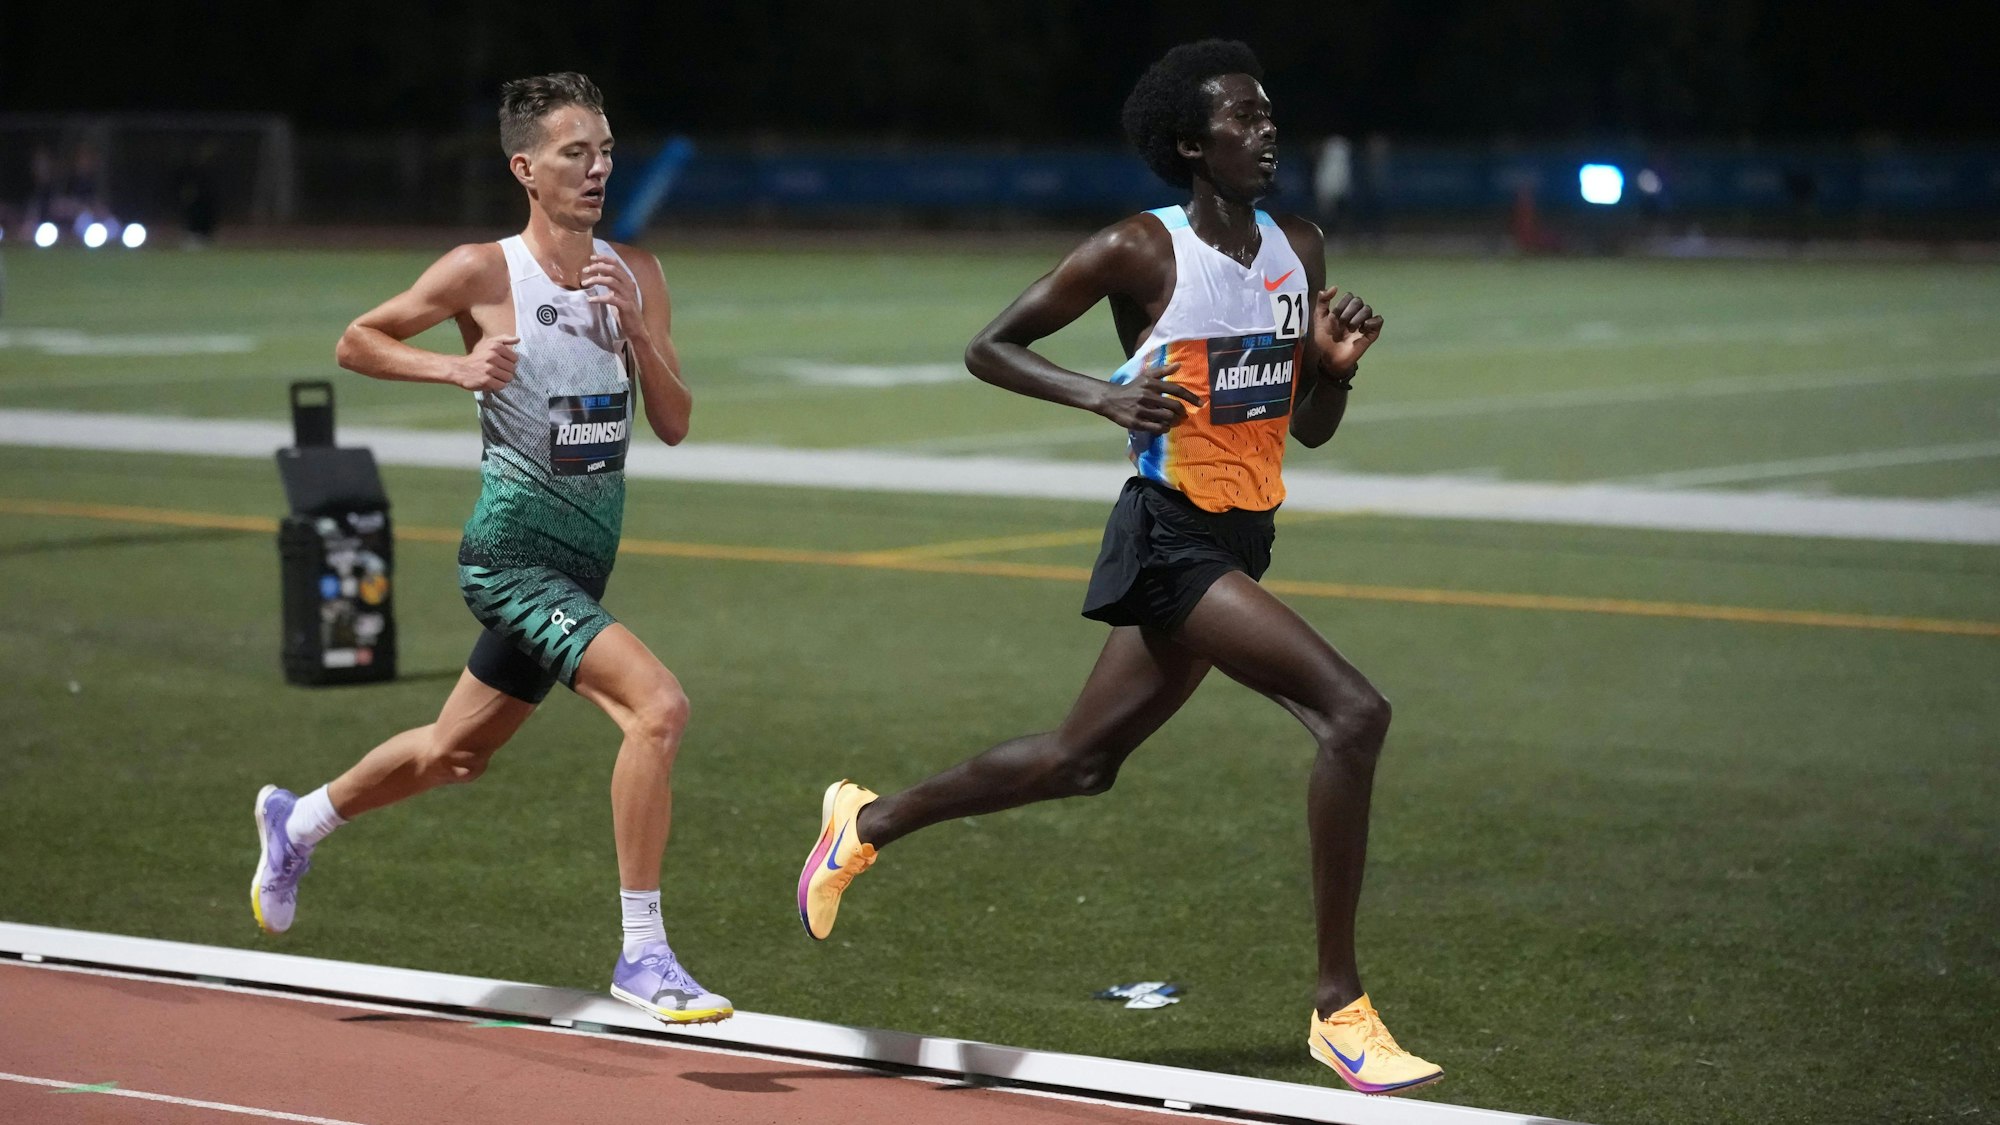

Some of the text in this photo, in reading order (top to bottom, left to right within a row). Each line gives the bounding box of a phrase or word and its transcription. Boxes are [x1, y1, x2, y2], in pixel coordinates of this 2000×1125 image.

[1277, 293, 1303, 334] 21
[1241, 335, 1272, 347] THE TEN
[1215, 360, 1293, 391] ABDILAAHI
[583, 396, 611, 407] THE TEN
[1246, 405, 1267, 419] HOKA
[587, 460, 606, 473] HOKA
